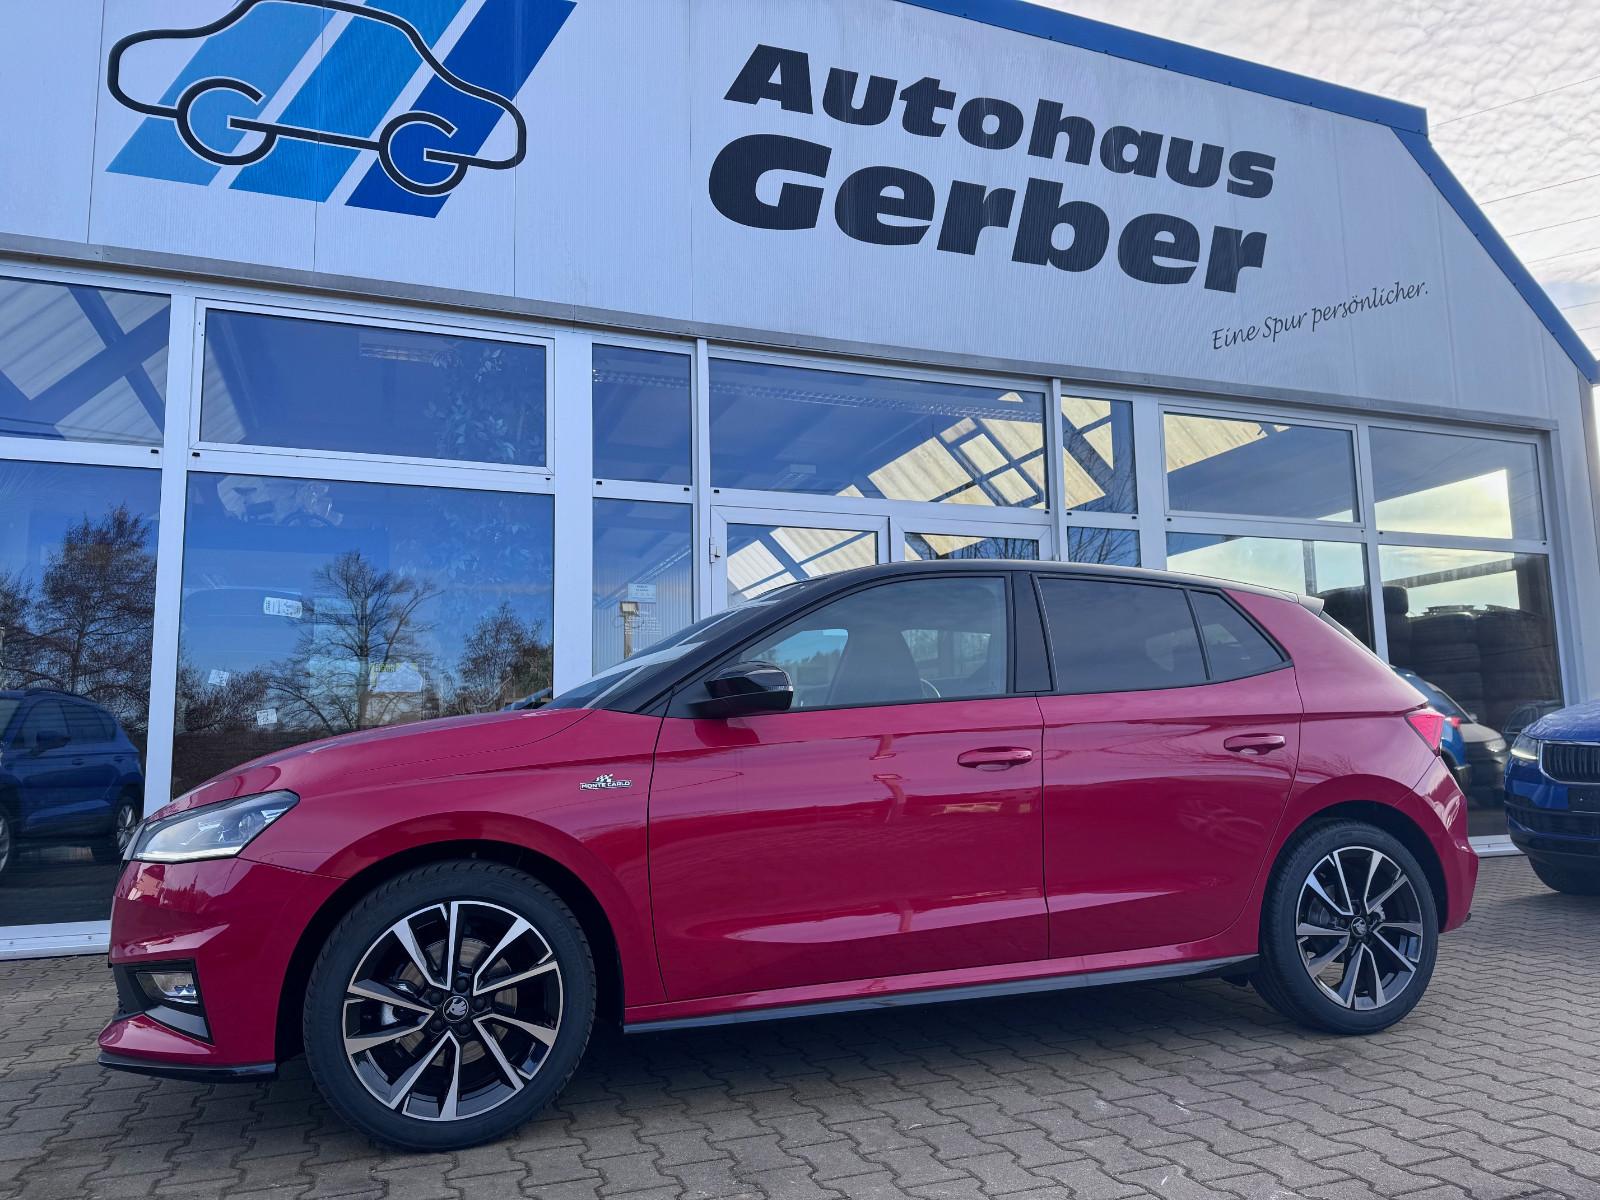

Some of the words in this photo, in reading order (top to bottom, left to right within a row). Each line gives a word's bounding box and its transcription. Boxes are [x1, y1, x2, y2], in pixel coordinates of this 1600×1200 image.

[724, 44, 1275, 199] Autohaus
[708, 133, 1267, 293] Gerber
[1211, 324, 1260, 350] Eine
[1262, 311, 1308, 342] Spur
[1311, 280, 1428, 332] persönlicher.
